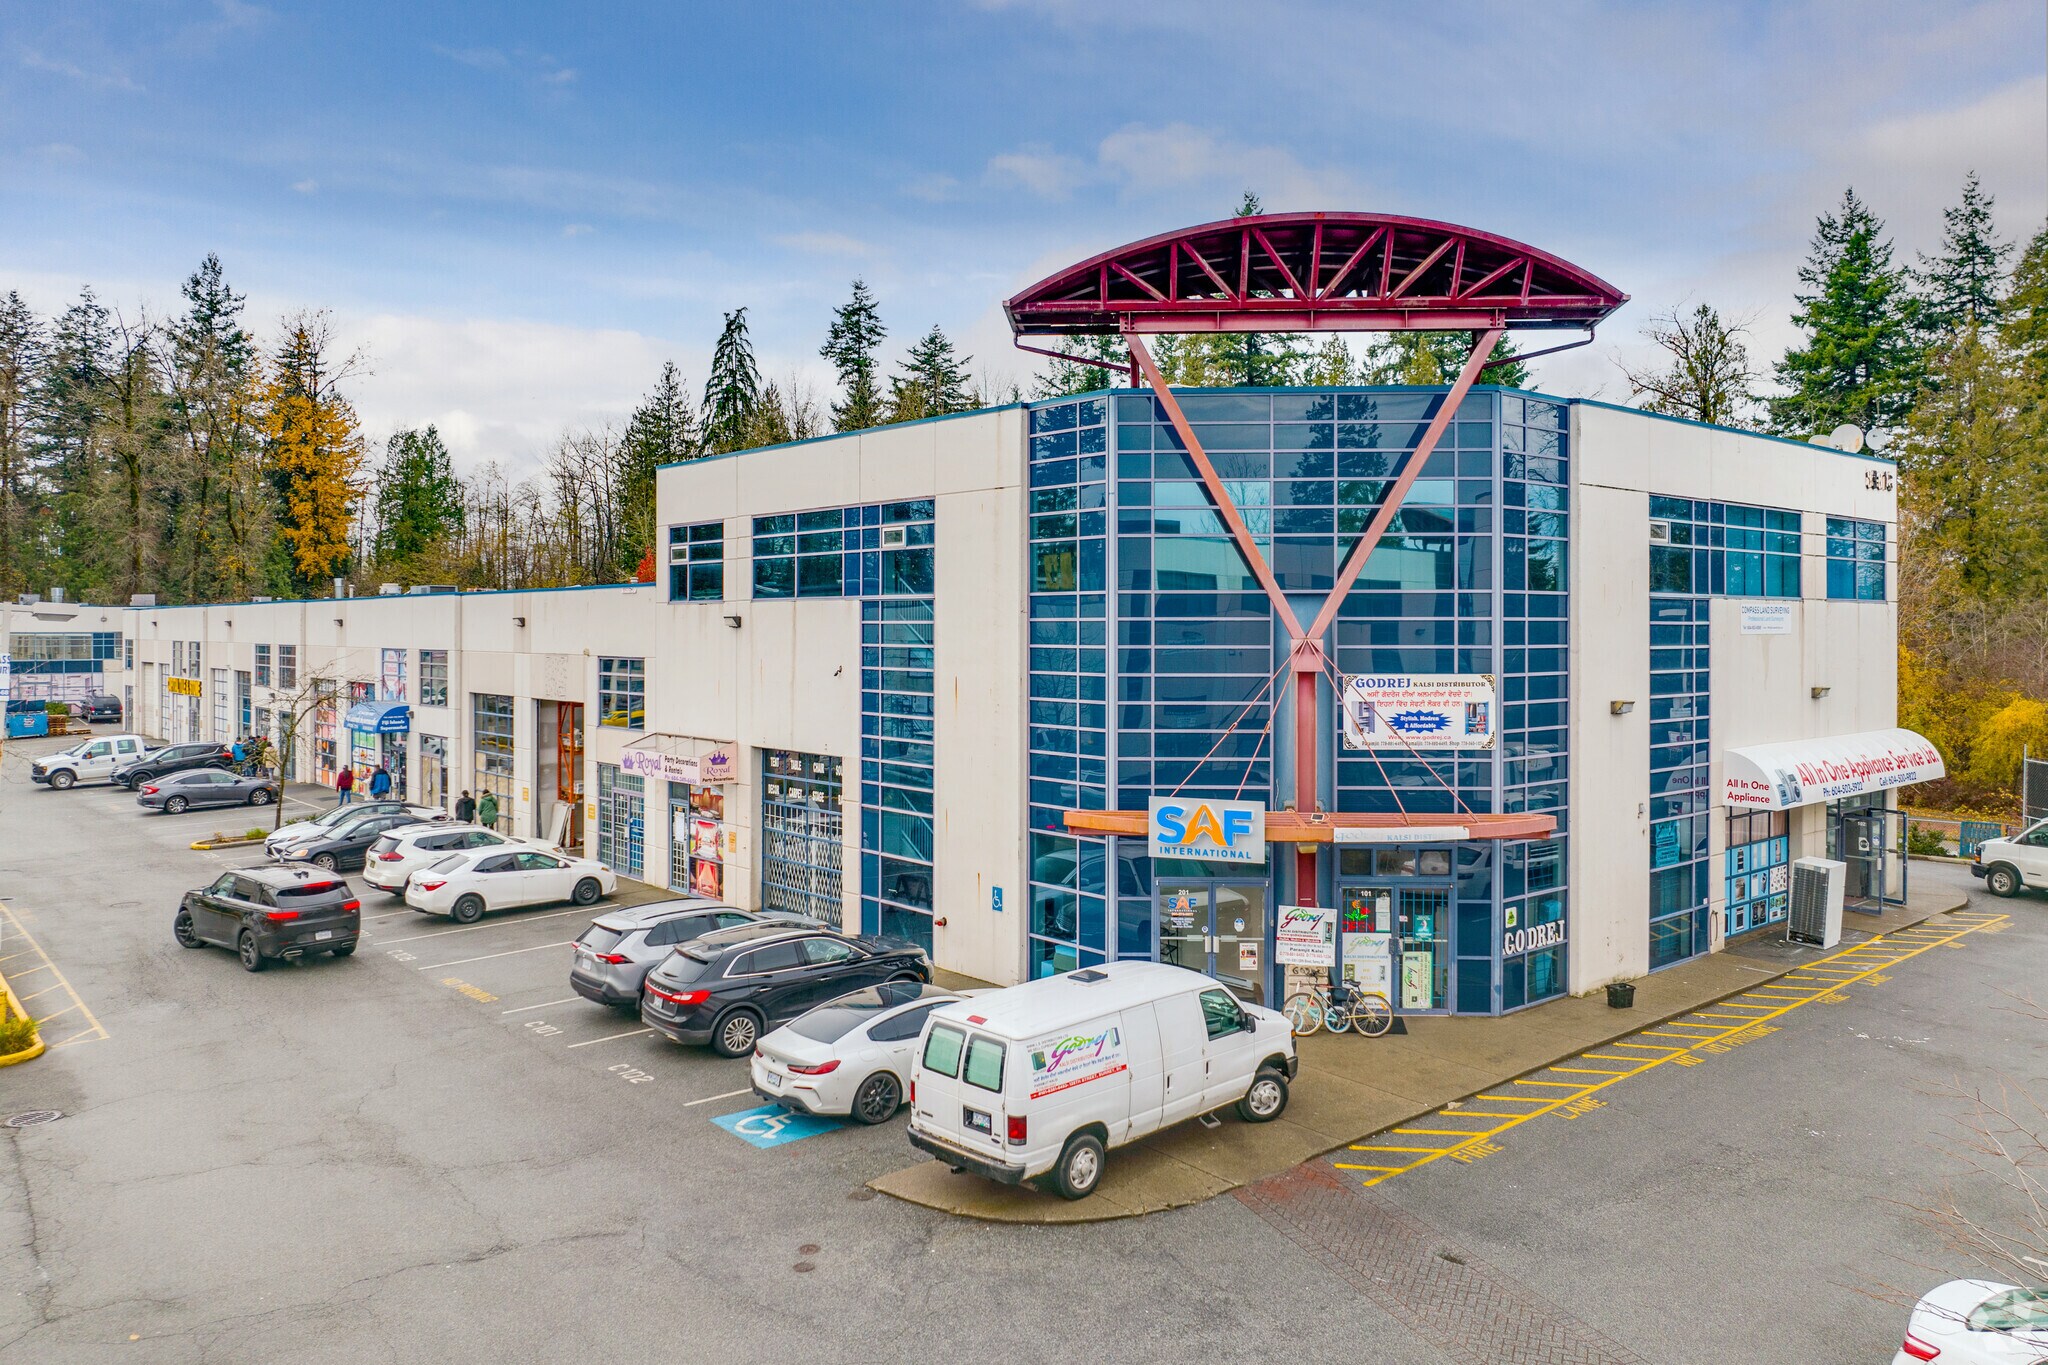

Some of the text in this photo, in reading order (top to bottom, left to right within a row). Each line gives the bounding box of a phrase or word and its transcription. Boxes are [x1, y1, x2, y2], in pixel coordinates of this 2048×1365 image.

[1355, 678, 1411, 688] GODREJ
[635, 751, 698, 777] Royal Party Decorations
[704, 766, 731, 777] Royal
[1795, 744, 1940, 787] All In One Appliance Service Ltd.
[1727, 778, 1770, 791] All In One
[1727, 791, 1770, 804] Appliance
[1156, 804, 1252, 847] SAF
[1160, 846, 1252, 859] INTERNATIONAL
[1168, 896, 1197, 909] SAF
[1341, 920, 1374, 933] OPEN
[1504, 919, 1565, 955] GODREJ
[524, 1020, 564, 1037] C101
[608, 1064, 654, 1084] C102
[1551, 1096, 1609, 1120] LANE
[1449, 1138, 1505, 1164] FIRE
